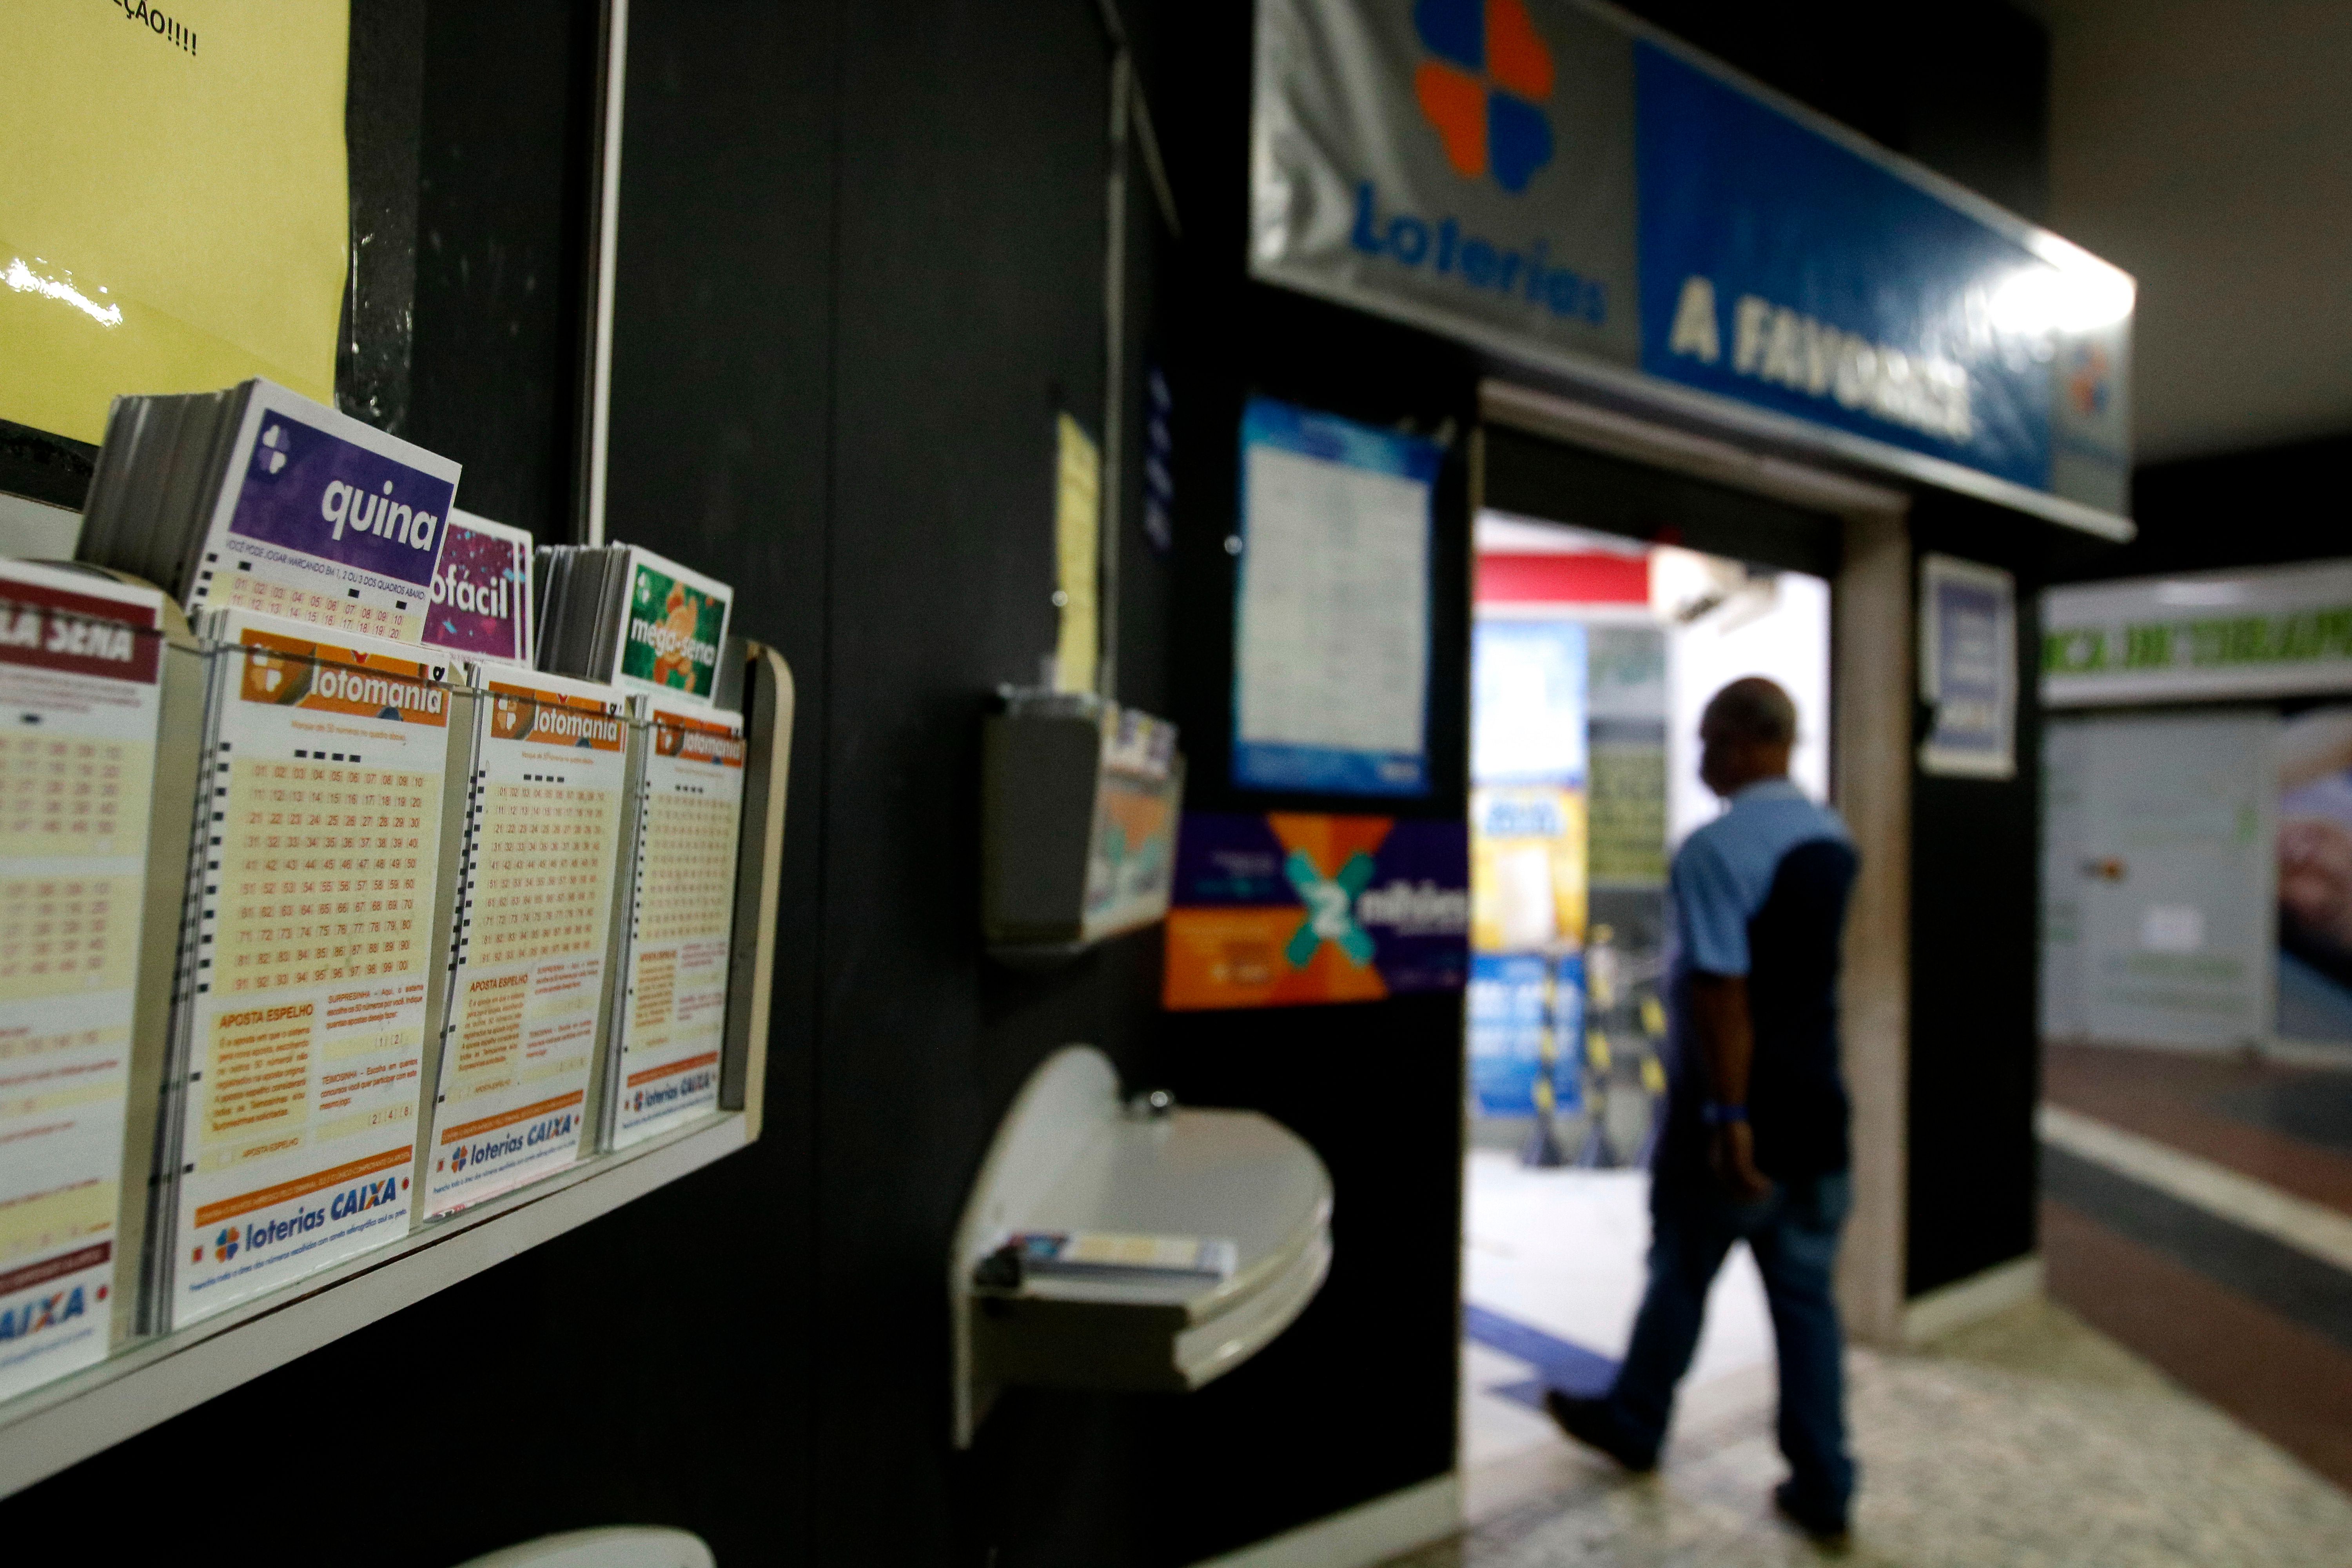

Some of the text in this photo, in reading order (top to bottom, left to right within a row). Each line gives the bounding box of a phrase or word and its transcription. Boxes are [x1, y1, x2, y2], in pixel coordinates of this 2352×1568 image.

[114, 0, 196, 56] ÇÃO!!!!
[1351, 180, 1605, 326] Loterias
[1669, 274, 1721, 364] A
[321, 480, 437, 552] quina
[265, 550, 287, 563] JOGAR
[288, 557, 325, 573] MARCANDO
[325, 566, 334, 575] EM
[342, 571, 347, 580] 2
[348, 572, 357, 582] OU
[358, 575, 363, 584] 3
[363, 577, 376, 588] DOS
[377, 580, 405, 595] QUADROS
[430, 564, 508, 619] ofácil
[273, 588, 283, 599] 03
[292, 592, 302, 602] 04
[310, 596, 320, 607] 05
[327, 600, 337, 611] 06
[345, 604, 355, 614] 07
[362, 608, 371, 619] 08
[377, 611, 387, 621] 09
[394, 615, 402, 625] 10
[290, 608, 298, 617] 14
[308, 612, 317, 622] 15
[325, 615, 333, 626] 16
[343, 619, 352, 629] 17
[360, 623, 368, 633] 18
[376, 626, 384, 635] 19
[390, 629, 399, 639] 20
[46, 619, 134, 663] SENA
[630, 618, 715, 666] mega-sena
[312, 665, 442, 714] lotomania
[534, 704, 617, 742] lotomania
[470, 978, 497, 992] APOSTA
[220, 1004, 314, 1029] APOSTA ESPELHO
[394, 1034, 399, 1044] 2
[372, 1114, 377, 1125] 2
[388, 1110, 393, 1119] 4
[470, 1132, 523, 1165] loterias
[527, 1113, 571, 1146] CAIXA
[246, 1205, 326, 1252] loterias
[330, 1176, 396, 1221] CAIXA
